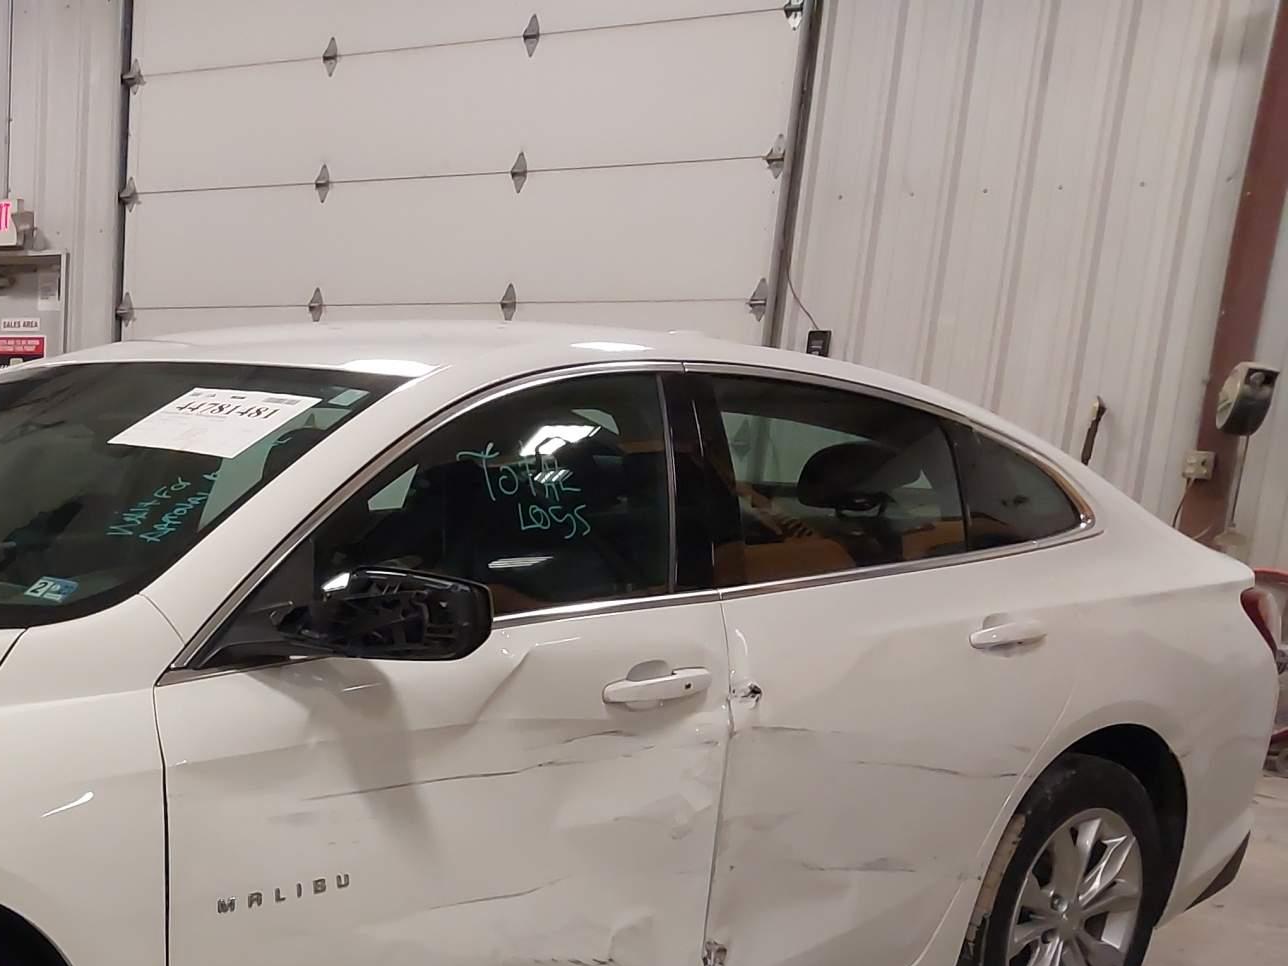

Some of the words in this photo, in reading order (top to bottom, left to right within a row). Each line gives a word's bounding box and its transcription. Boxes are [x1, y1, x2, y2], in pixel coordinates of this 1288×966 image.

[3, 320, 21, 329] SALES
[22, 320, 39, 328] AREA
[176, 400, 280, 420] 44781481
[518, 502, 591, 539] LOSS
[217, 873, 350, 914] MALIBU
